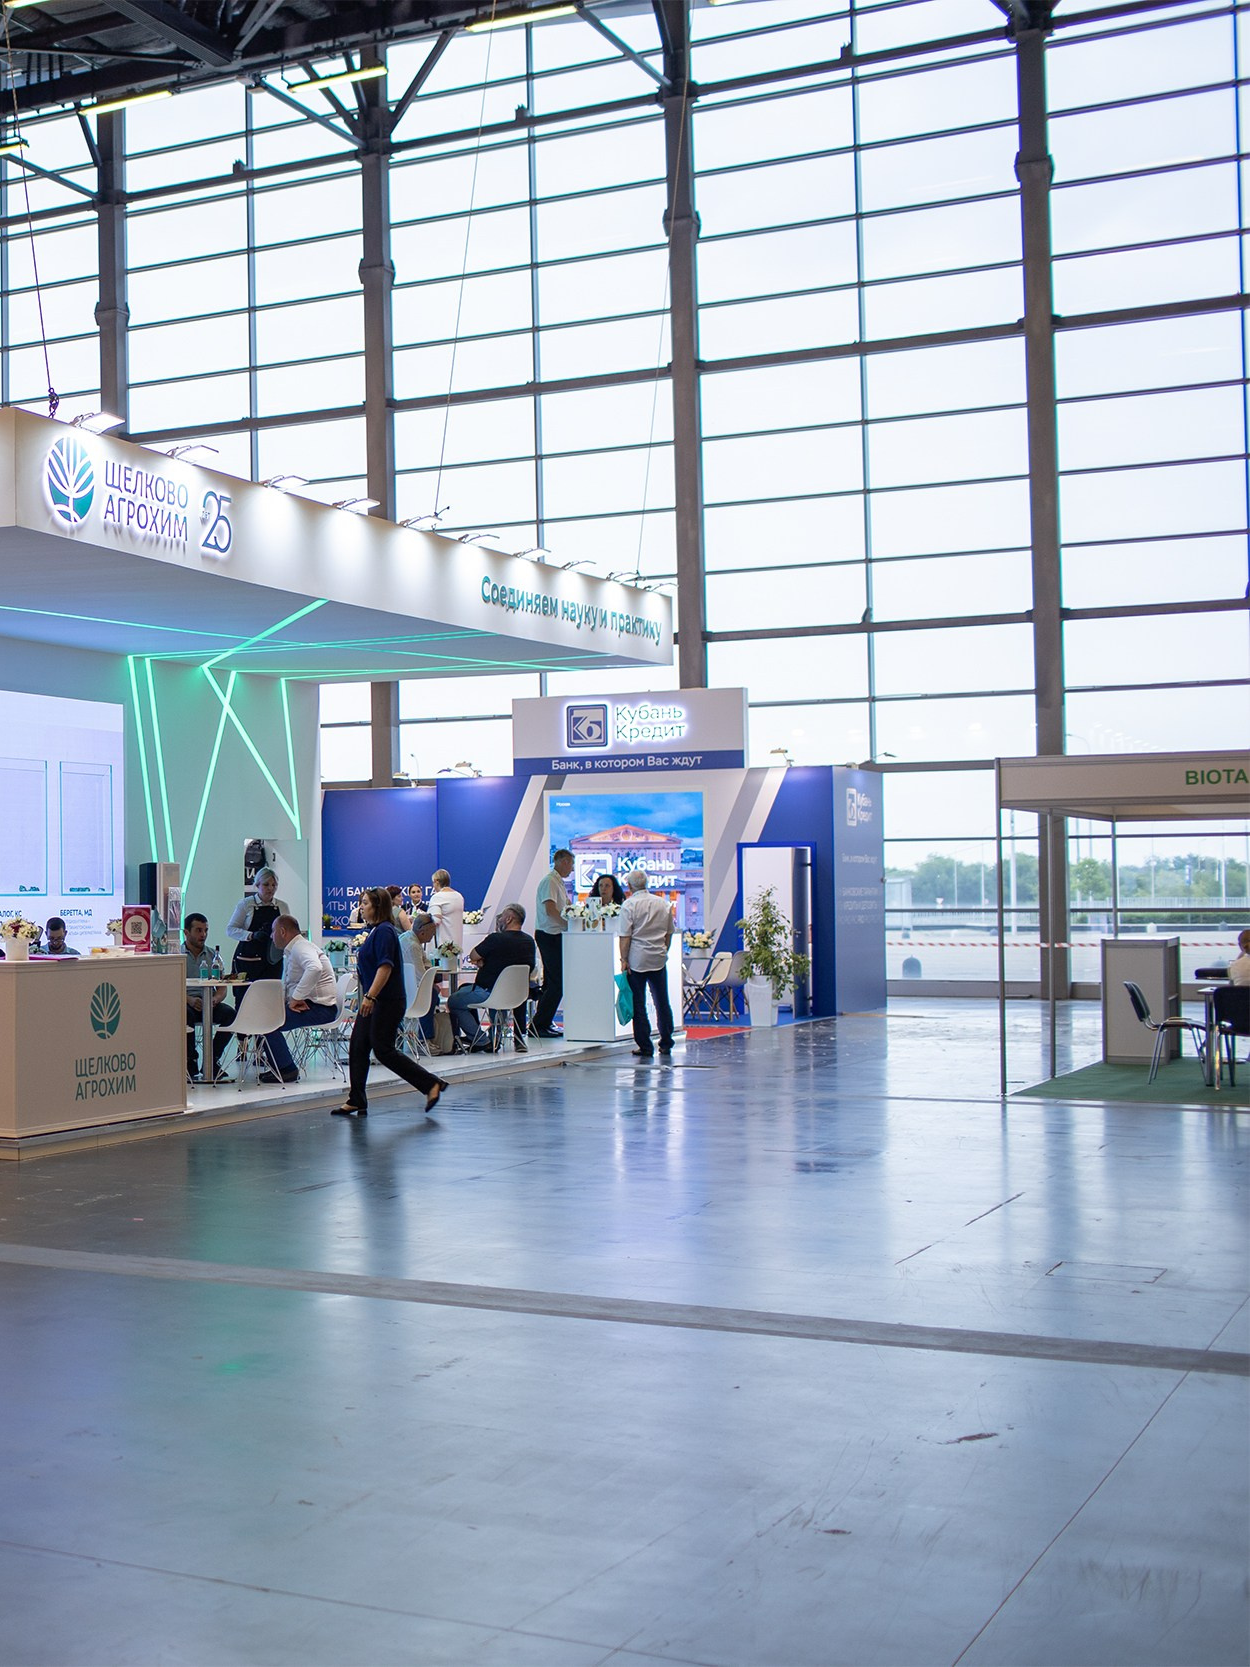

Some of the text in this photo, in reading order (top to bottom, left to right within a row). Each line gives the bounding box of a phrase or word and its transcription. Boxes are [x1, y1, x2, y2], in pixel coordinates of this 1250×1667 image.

[105, 460, 188, 509] ЩЕЛКОВО
[104, 494, 188, 541] АГРОХИМ
[202, 491, 232, 553] 25
[481, 575, 662, 646] Соединяем науку и практику
[616, 705, 683, 724] Кубань
[616, 725, 685, 742] Кредит
[552, 755, 702, 771] Банк, в котором Вас ждут
[1185, 769, 1249, 785] BIOTA
[617, 856, 675, 874] Кубань
[617, 874, 677, 889] Кдит
[75, 1052, 136, 1079] ЩЕЛКОВО
[75, 1074, 136, 1101] АГРОХИМ
